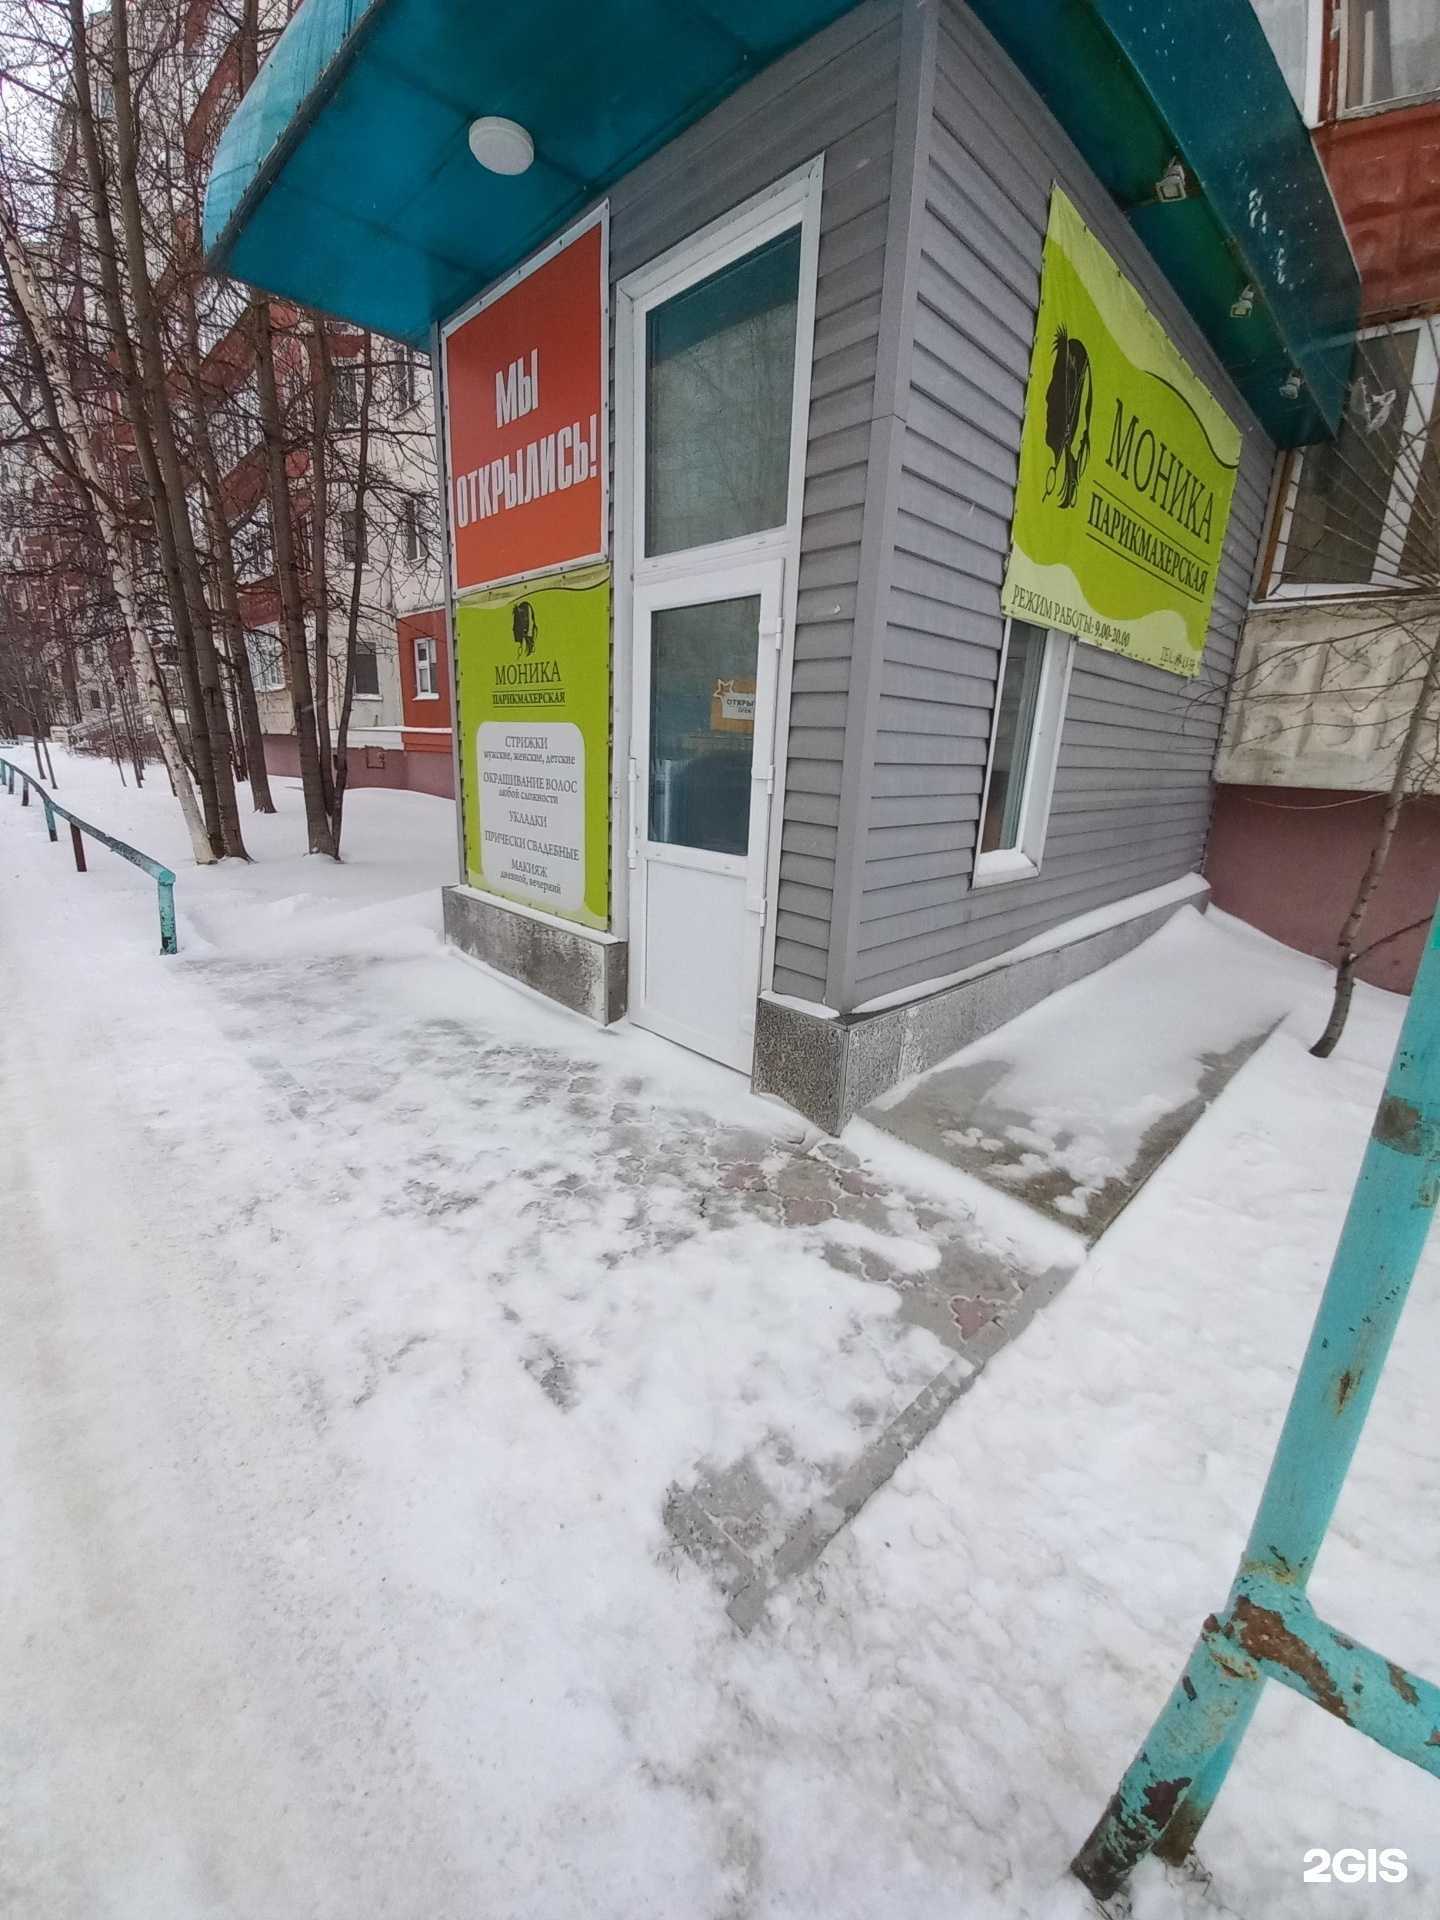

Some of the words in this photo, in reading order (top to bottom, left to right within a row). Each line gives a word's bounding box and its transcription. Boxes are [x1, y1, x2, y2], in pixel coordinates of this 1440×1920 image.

[495, 348, 539, 429] МЫ
[456, 414, 598, 528] ОТКРЫЛИСЬ!
[1105, 398, 1214, 544] МОНИКА
[1087, 492, 1209, 595] ПАРИКМАХЕРСКАЯ
[1011, 584, 1053, 620] РЕЖИМ
[1053, 602, 1094, 634] РАБОТЫ:
[494, 660, 562, 685] МОНИКА
[492, 691, 566, 705] ПАРИКМАХЕРСКАЯ
[505, 735, 548, 750] СТРИЖКИ
[545, 754, 576, 765] детские
[483, 771, 545, 790] ОКРАШИВАНИЕ
[545, 778, 578, 794] ВОЛОС
[508, 809, 547, 828] УКЛАДКИ
[485, 830, 526, 849] ПРИЧЕСКИ
[526, 839, 580, 861] СВАДЕБНЫЕ
[511, 858, 548, 878] МАКИЯЖ
